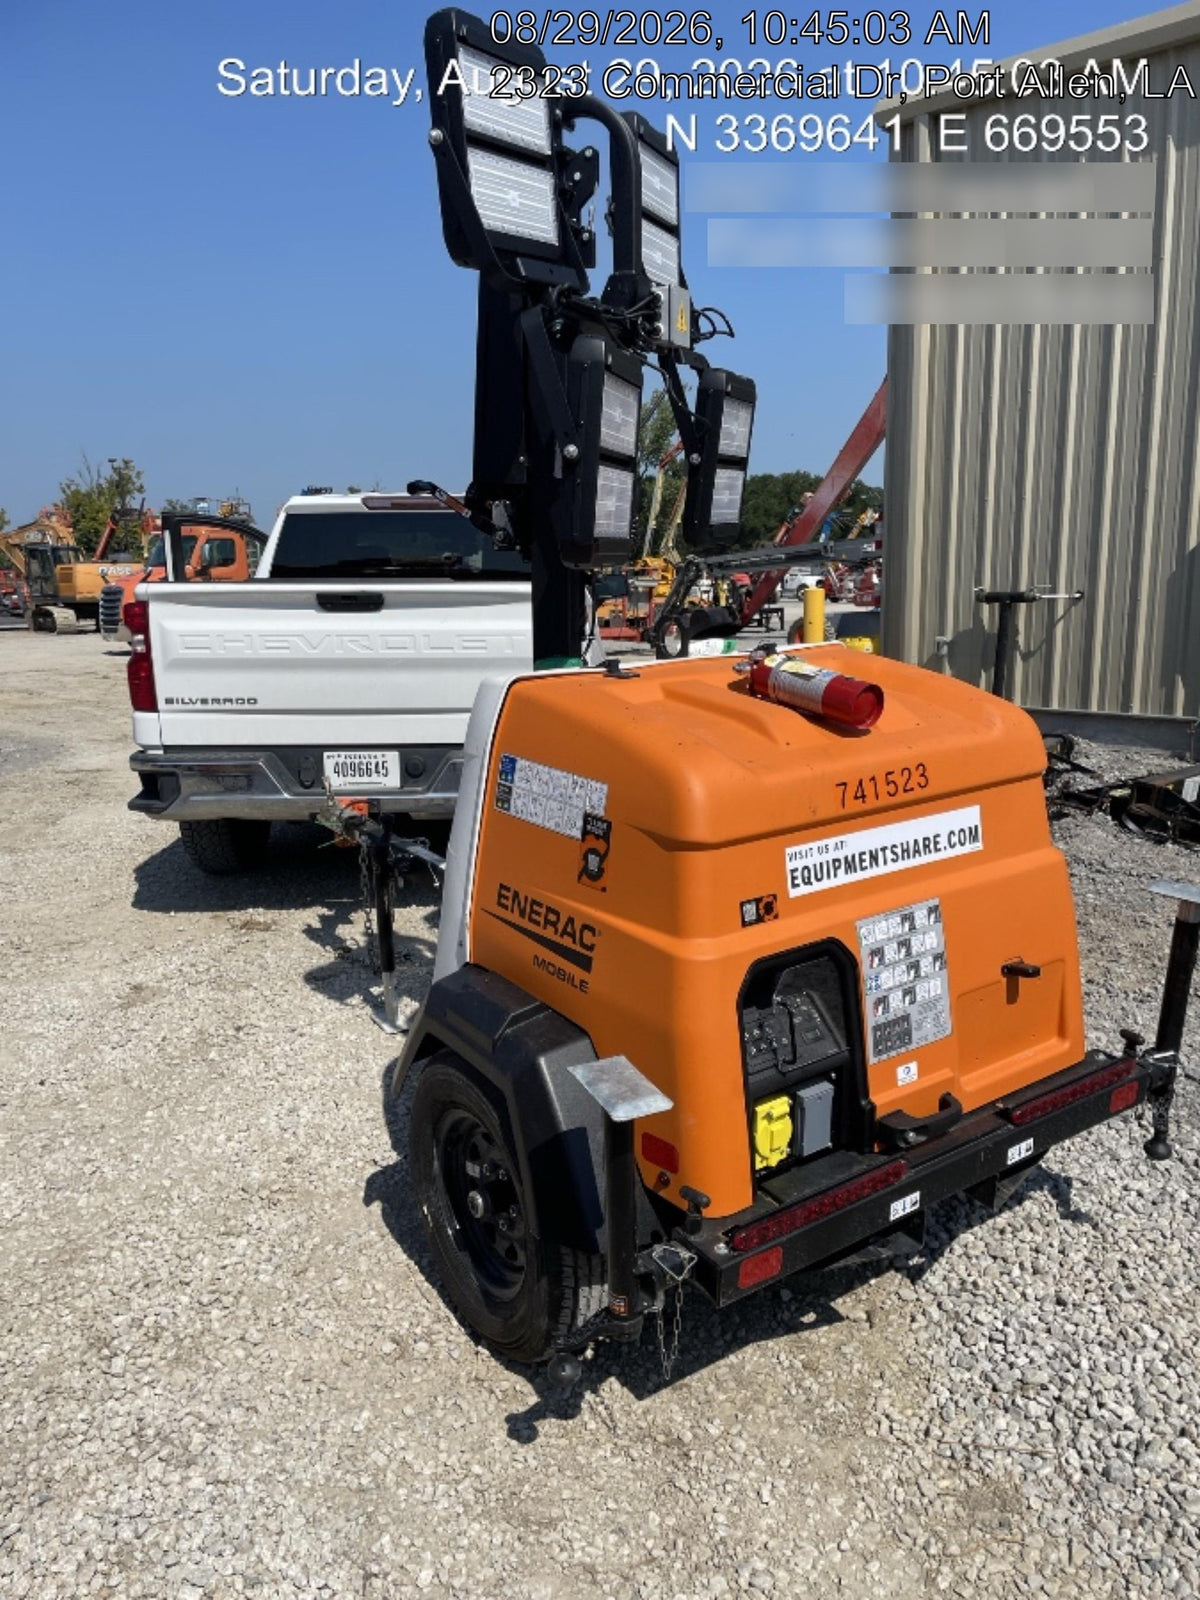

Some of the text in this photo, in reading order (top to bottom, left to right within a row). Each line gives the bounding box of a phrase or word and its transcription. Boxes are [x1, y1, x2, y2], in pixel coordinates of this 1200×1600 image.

[178, 633, 525, 655] CHEVROLET
[164, 696, 259, 706] SILVERADO
[333, 760, 389, 778] 4096645
[836, 762, 930, 809] 741523
[787, 849, 814, 864] VISIT
[817, 844, 830, 856] US
[789, 823, 981, 890] EQUIPMENTSHARE.COM
[496, 882, 598, 953] ENERAC
[532, 953, 591, 995] MOBILE
